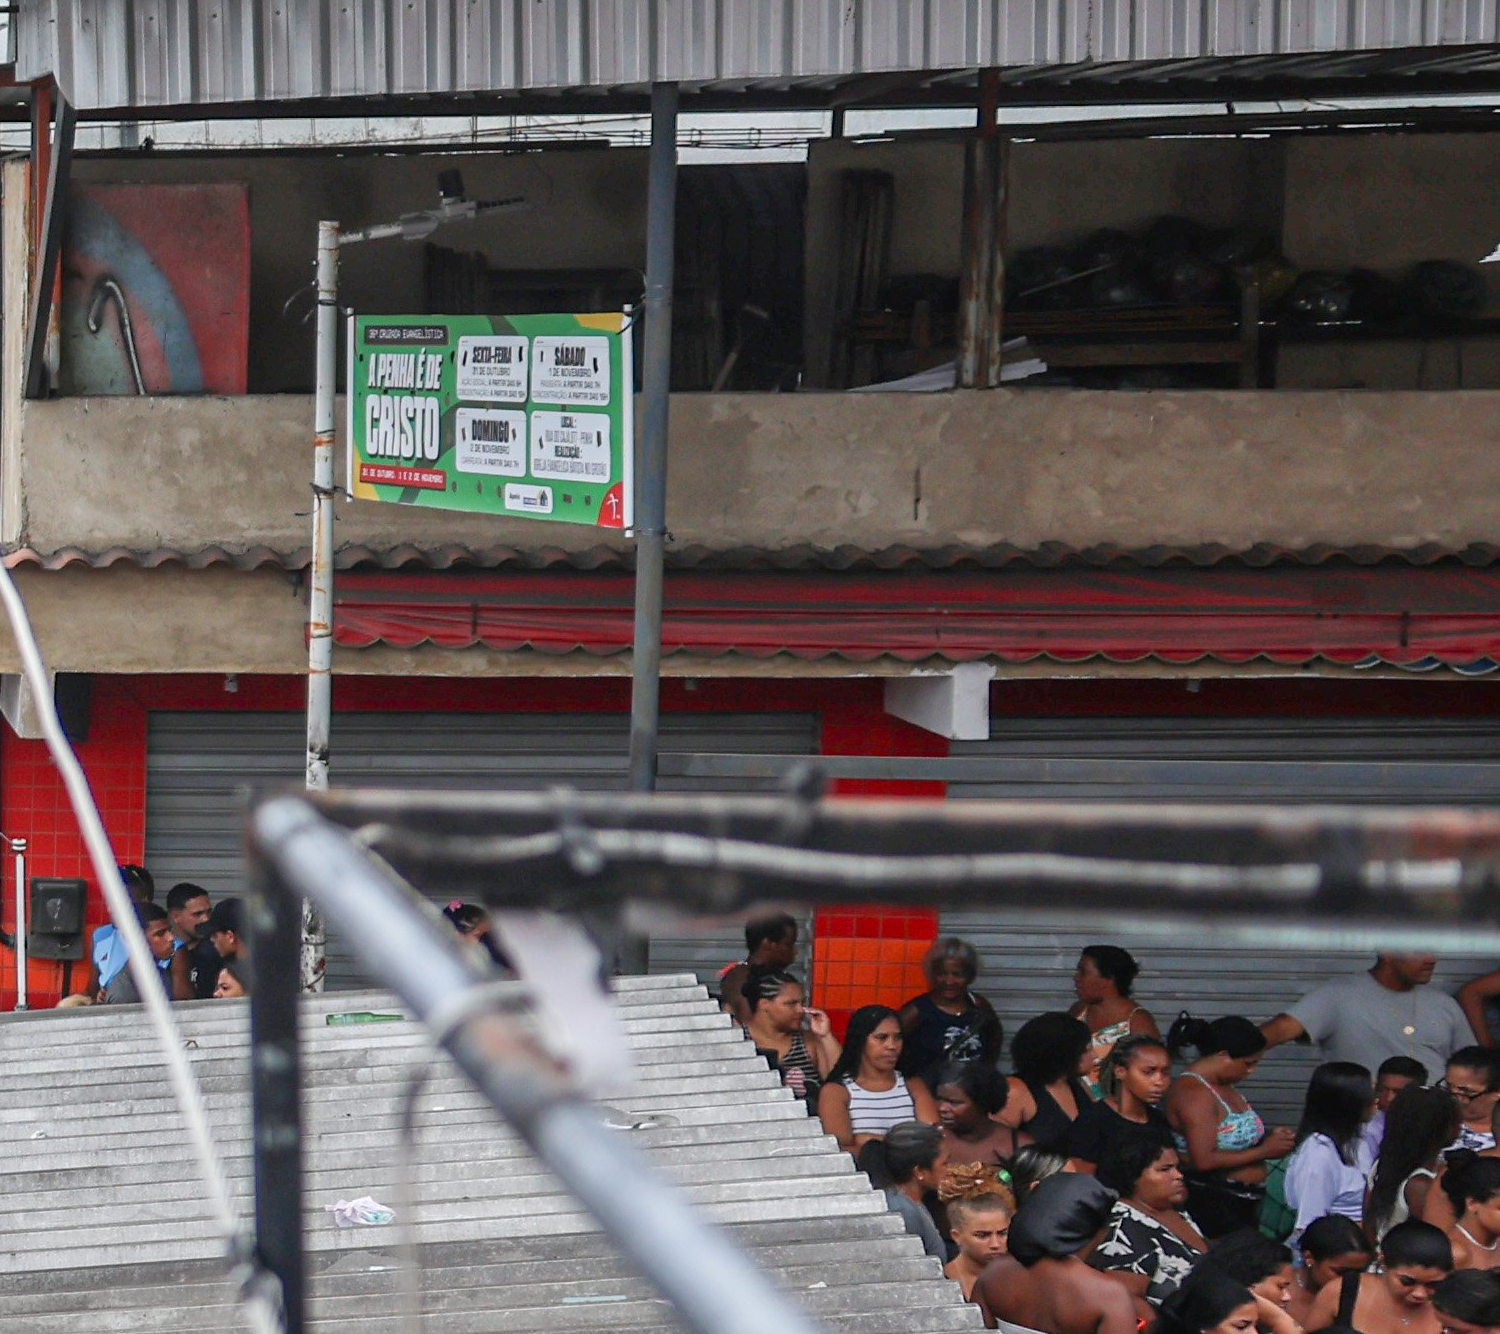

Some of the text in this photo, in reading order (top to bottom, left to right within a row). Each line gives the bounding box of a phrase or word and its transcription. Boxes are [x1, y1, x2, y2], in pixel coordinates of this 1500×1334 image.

[473, 346, 512, 363] SEXTA-FEIRA
[555, 343, 586, 366] SÁBADO
[368, 347, 443, 390] A PENHA É DE
[365, 394, 440, 460] CRISTO
[472, 419, 510, 443] DOMINGO
